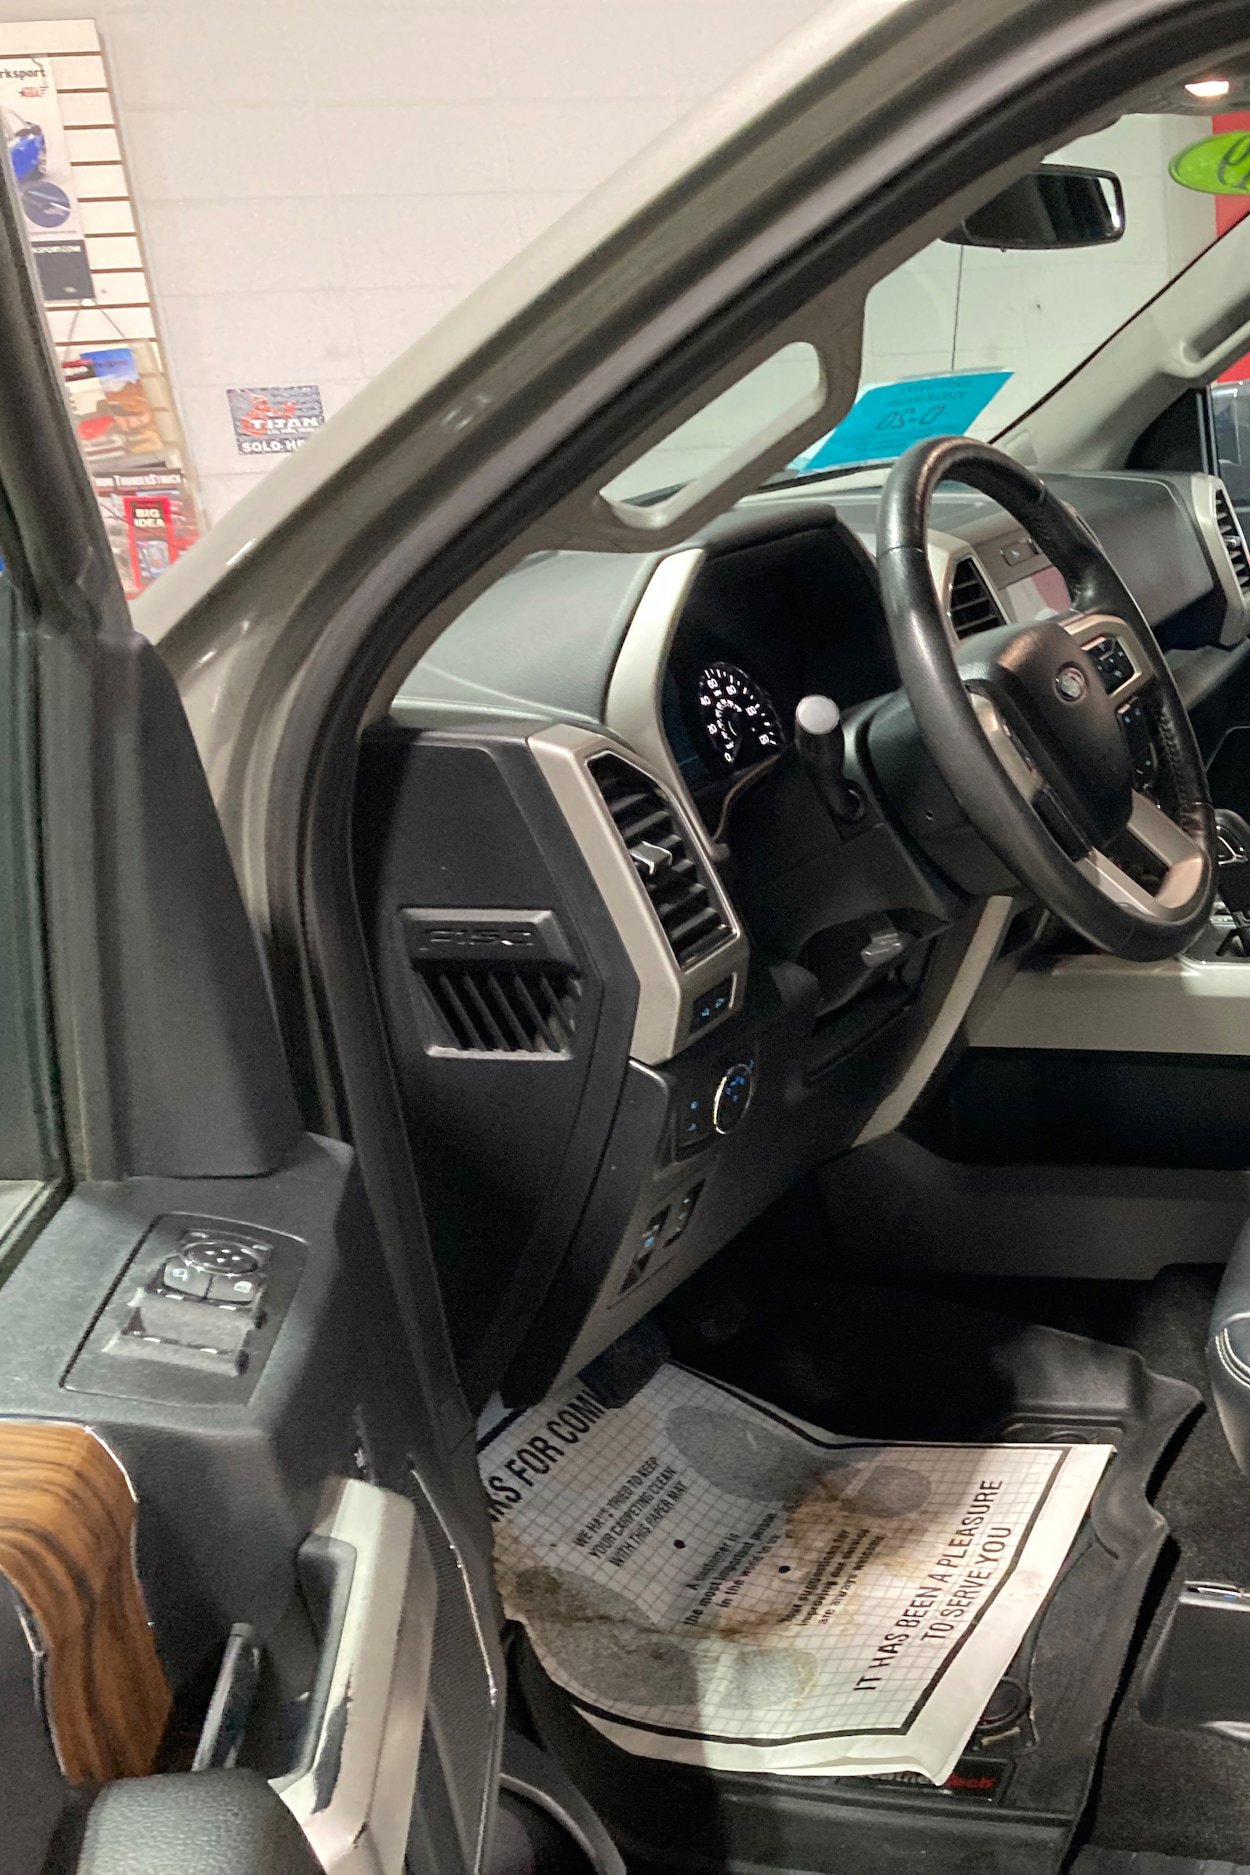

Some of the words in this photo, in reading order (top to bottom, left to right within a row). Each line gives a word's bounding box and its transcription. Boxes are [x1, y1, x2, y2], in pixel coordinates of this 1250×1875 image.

[251, 417, 320, 430] TITAN
[242, 440, 282, 453] SOLD
[133, 518, 166, 528] IDEA
[134, 508, 161, 519] BIG
[504, 1436, 565, 1487] FOR
[572, 1529, 593, 1547] WE
[606, 1485, 634, 1510] TRIED
[627, 1475, 643, 1488] TO
[636, 1456, 659, 1478] KEEP
[588, 1532, 616, 1559] YOUR
[610, 1491, 655, 1536] CARPETING
[648, 1466, 677, 1494] CLEAN
[609, 1541, 636, 1567] WITH
[629, 1523, 652, 1545] THIS
[644, 1499, 674, 1529] PAPER
[667, 1481, 689, 1501] MAT
[936, 1480, 1003, 1569] PLEASURE
[694, 1542, 731, 1581] customer
[927, 1573, 952, 1583] A
[682, 1609, 703, 1626] the
[698, 1581, 723, 1607] most
[724, 1580, 745, 1595] the
[818, 1608, 835, 1625] are
[831, 1574, 858, 1606] always
[920, 1623, 955, 1642] TO
[940, 1570, 993, 1618] SERVE
[974, 1527, 1012, 1564] YOU
[895, 1585, 943, 1629] BEEN
[868, 1632, 910, 1670] HAS
[852, 1675, 883, 1691] IT
